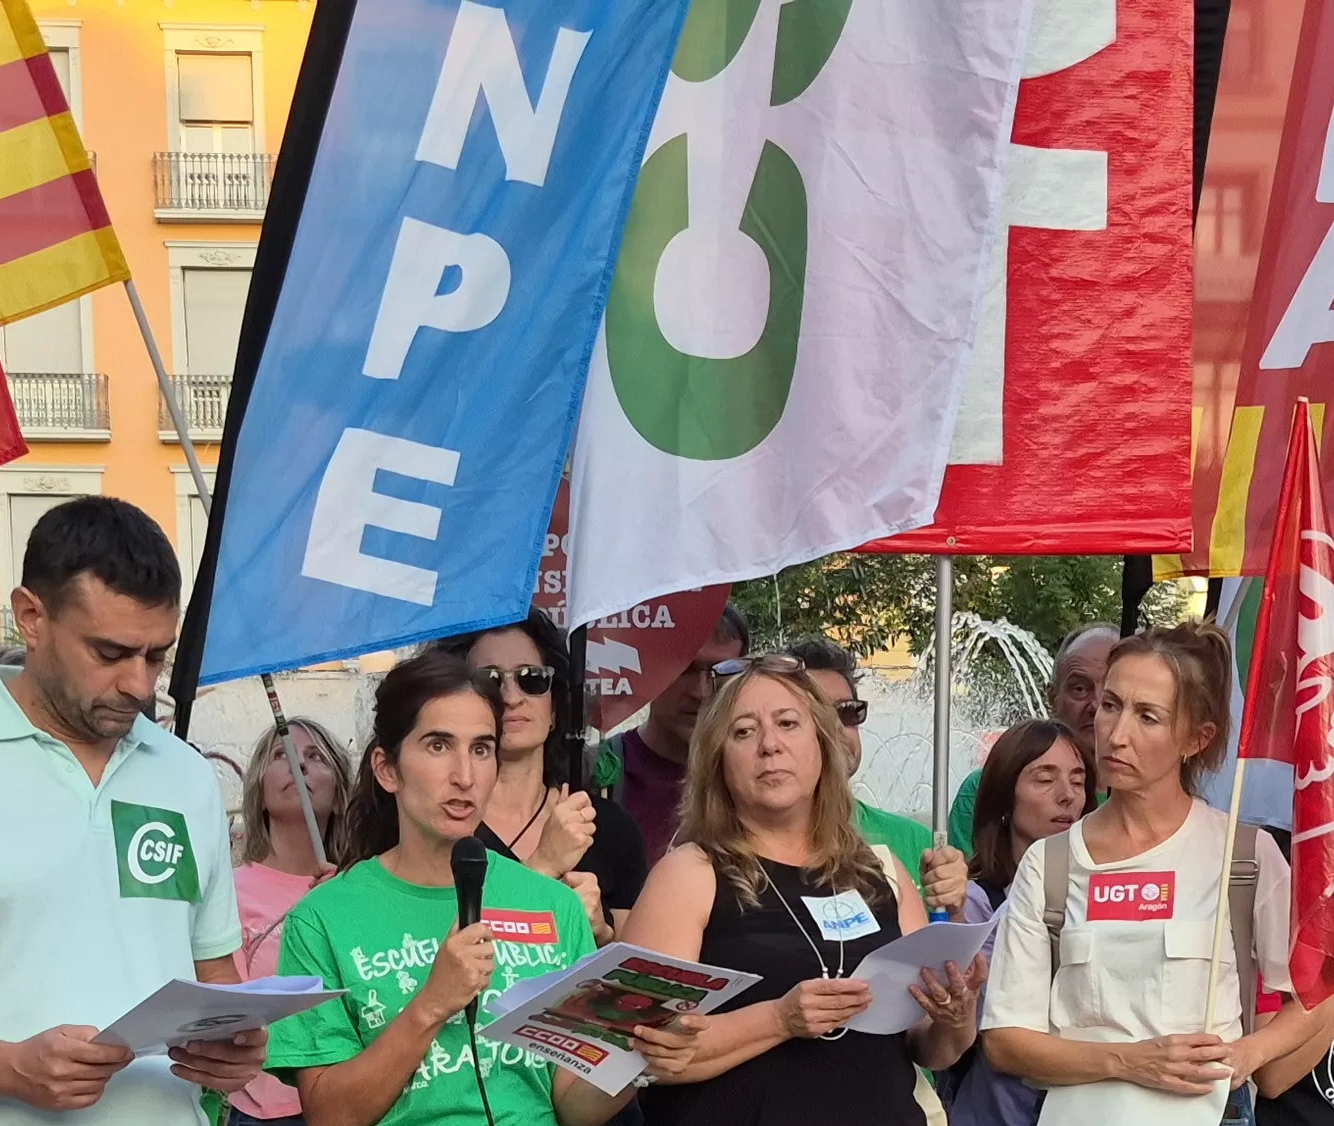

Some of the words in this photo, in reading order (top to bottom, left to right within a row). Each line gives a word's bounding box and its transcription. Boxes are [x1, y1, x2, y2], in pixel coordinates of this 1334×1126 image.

[585, 677, 633, 695] TEA
[140, 839, 184, 865] CSIF
[1093, 884, 1139, 903] UGT
[1138, 903, 1168, 912] Aragón
[519, 1026, 581, 1051] CCOO
